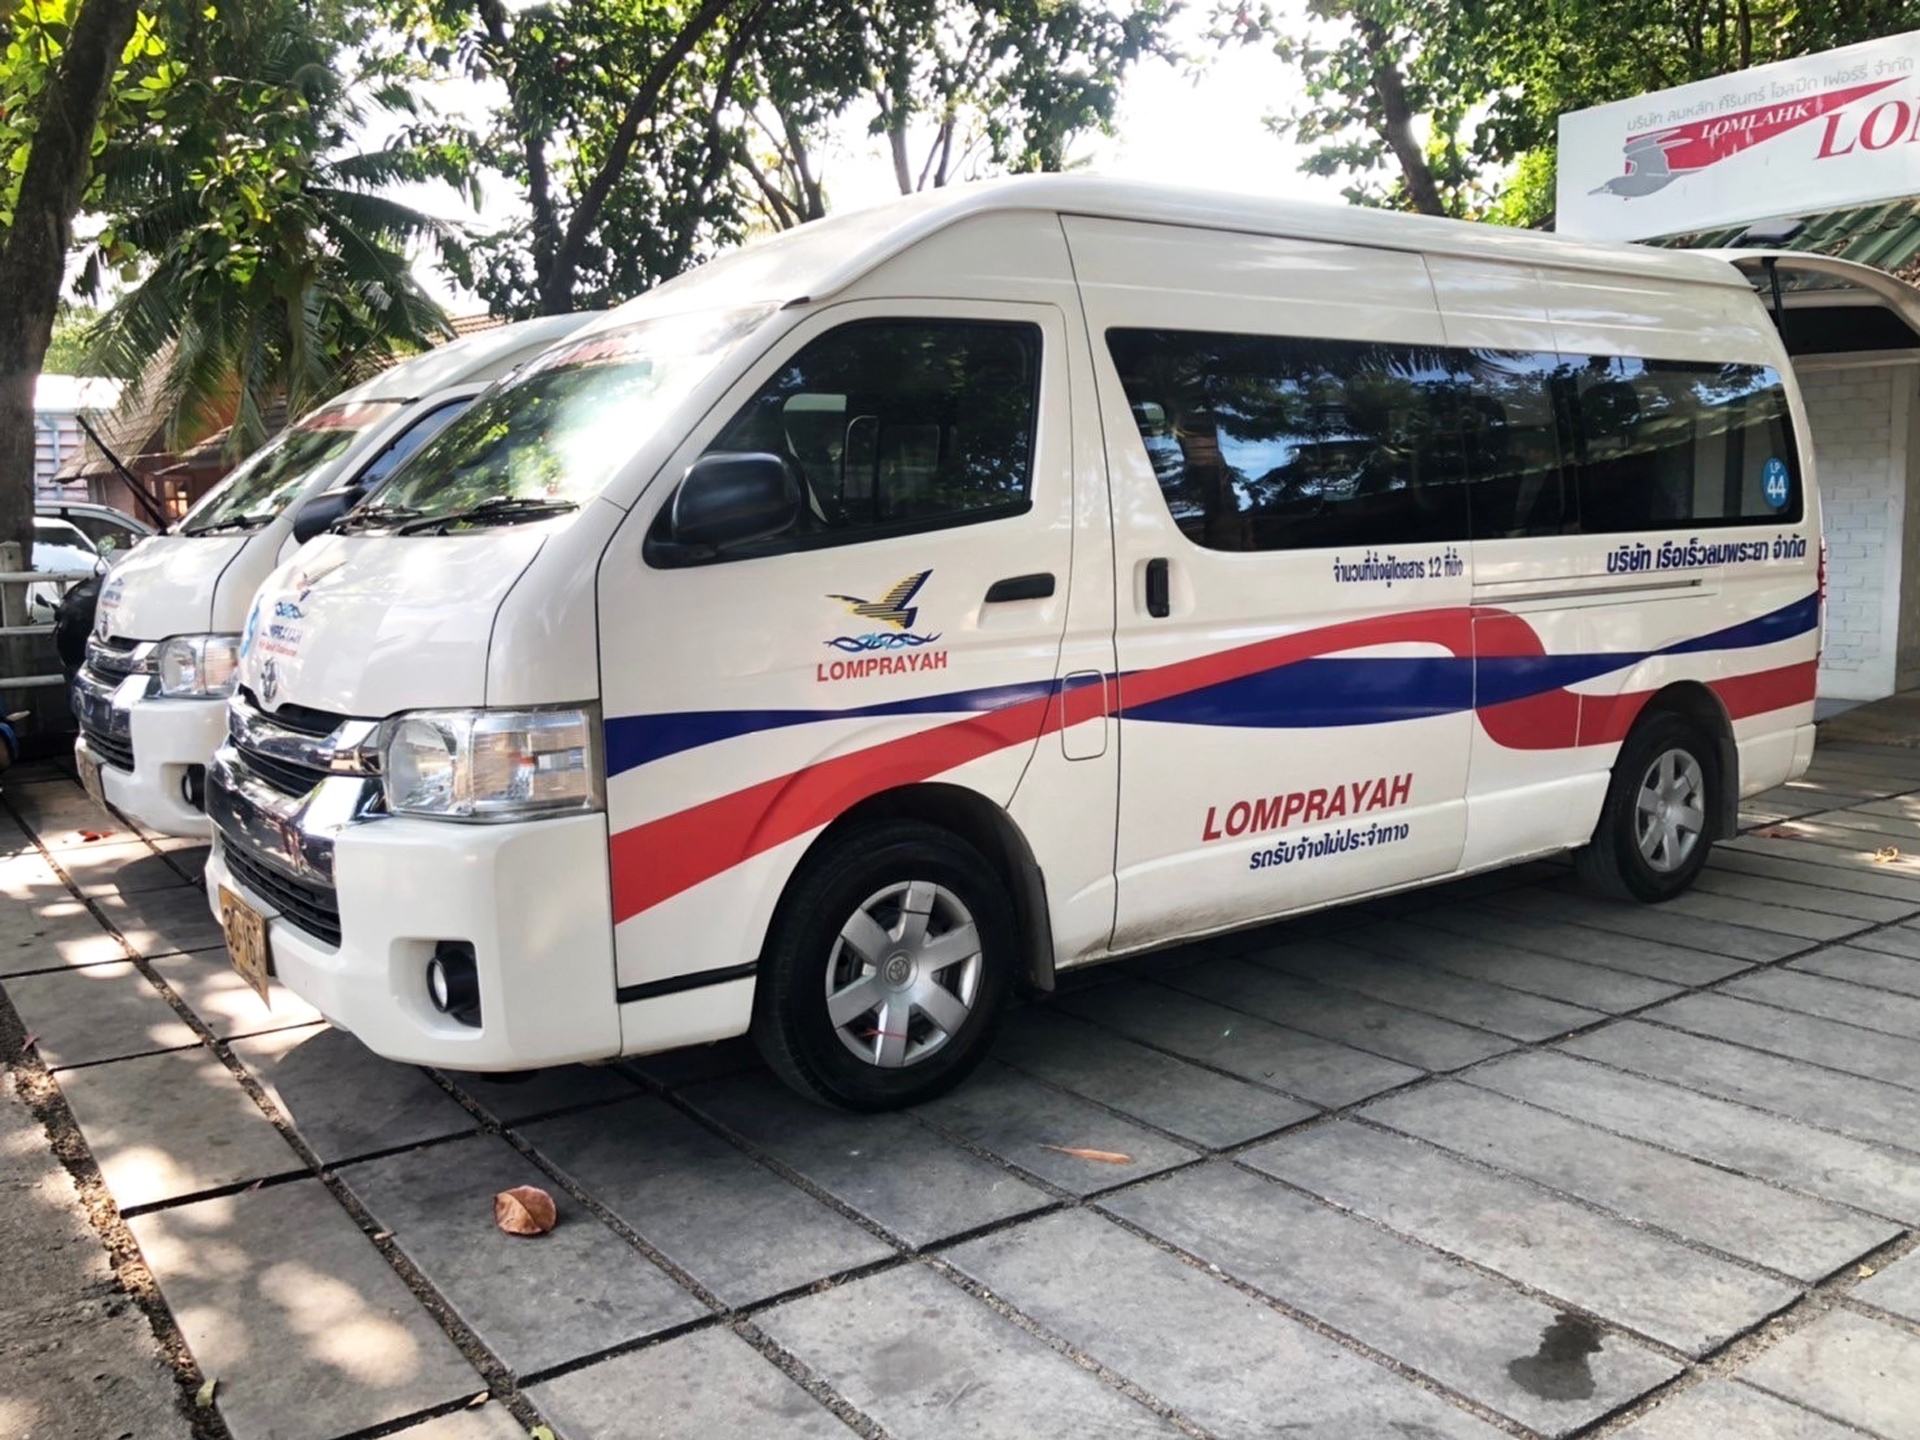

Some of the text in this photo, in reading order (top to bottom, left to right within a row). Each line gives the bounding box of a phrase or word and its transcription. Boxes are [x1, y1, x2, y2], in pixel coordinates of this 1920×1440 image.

[1626, 111, 1663, 132] บริษัท
[1701, 102, 1811, 139] LOMLAHK
[1767, 474, 1787, 499] 44
[1428, 556, 1442, 578] 12
[1606, 533, 1807, 573] บริษัท เรือเร็วลมพระยา จำกัด
[816, 650, 948, 682] LOMPRAYAH
[1202, 773, 1413, 841] LOMPRAYAH
[1249, 822, 1410, 870] รถรับจ้างไม่ประจำทาง
